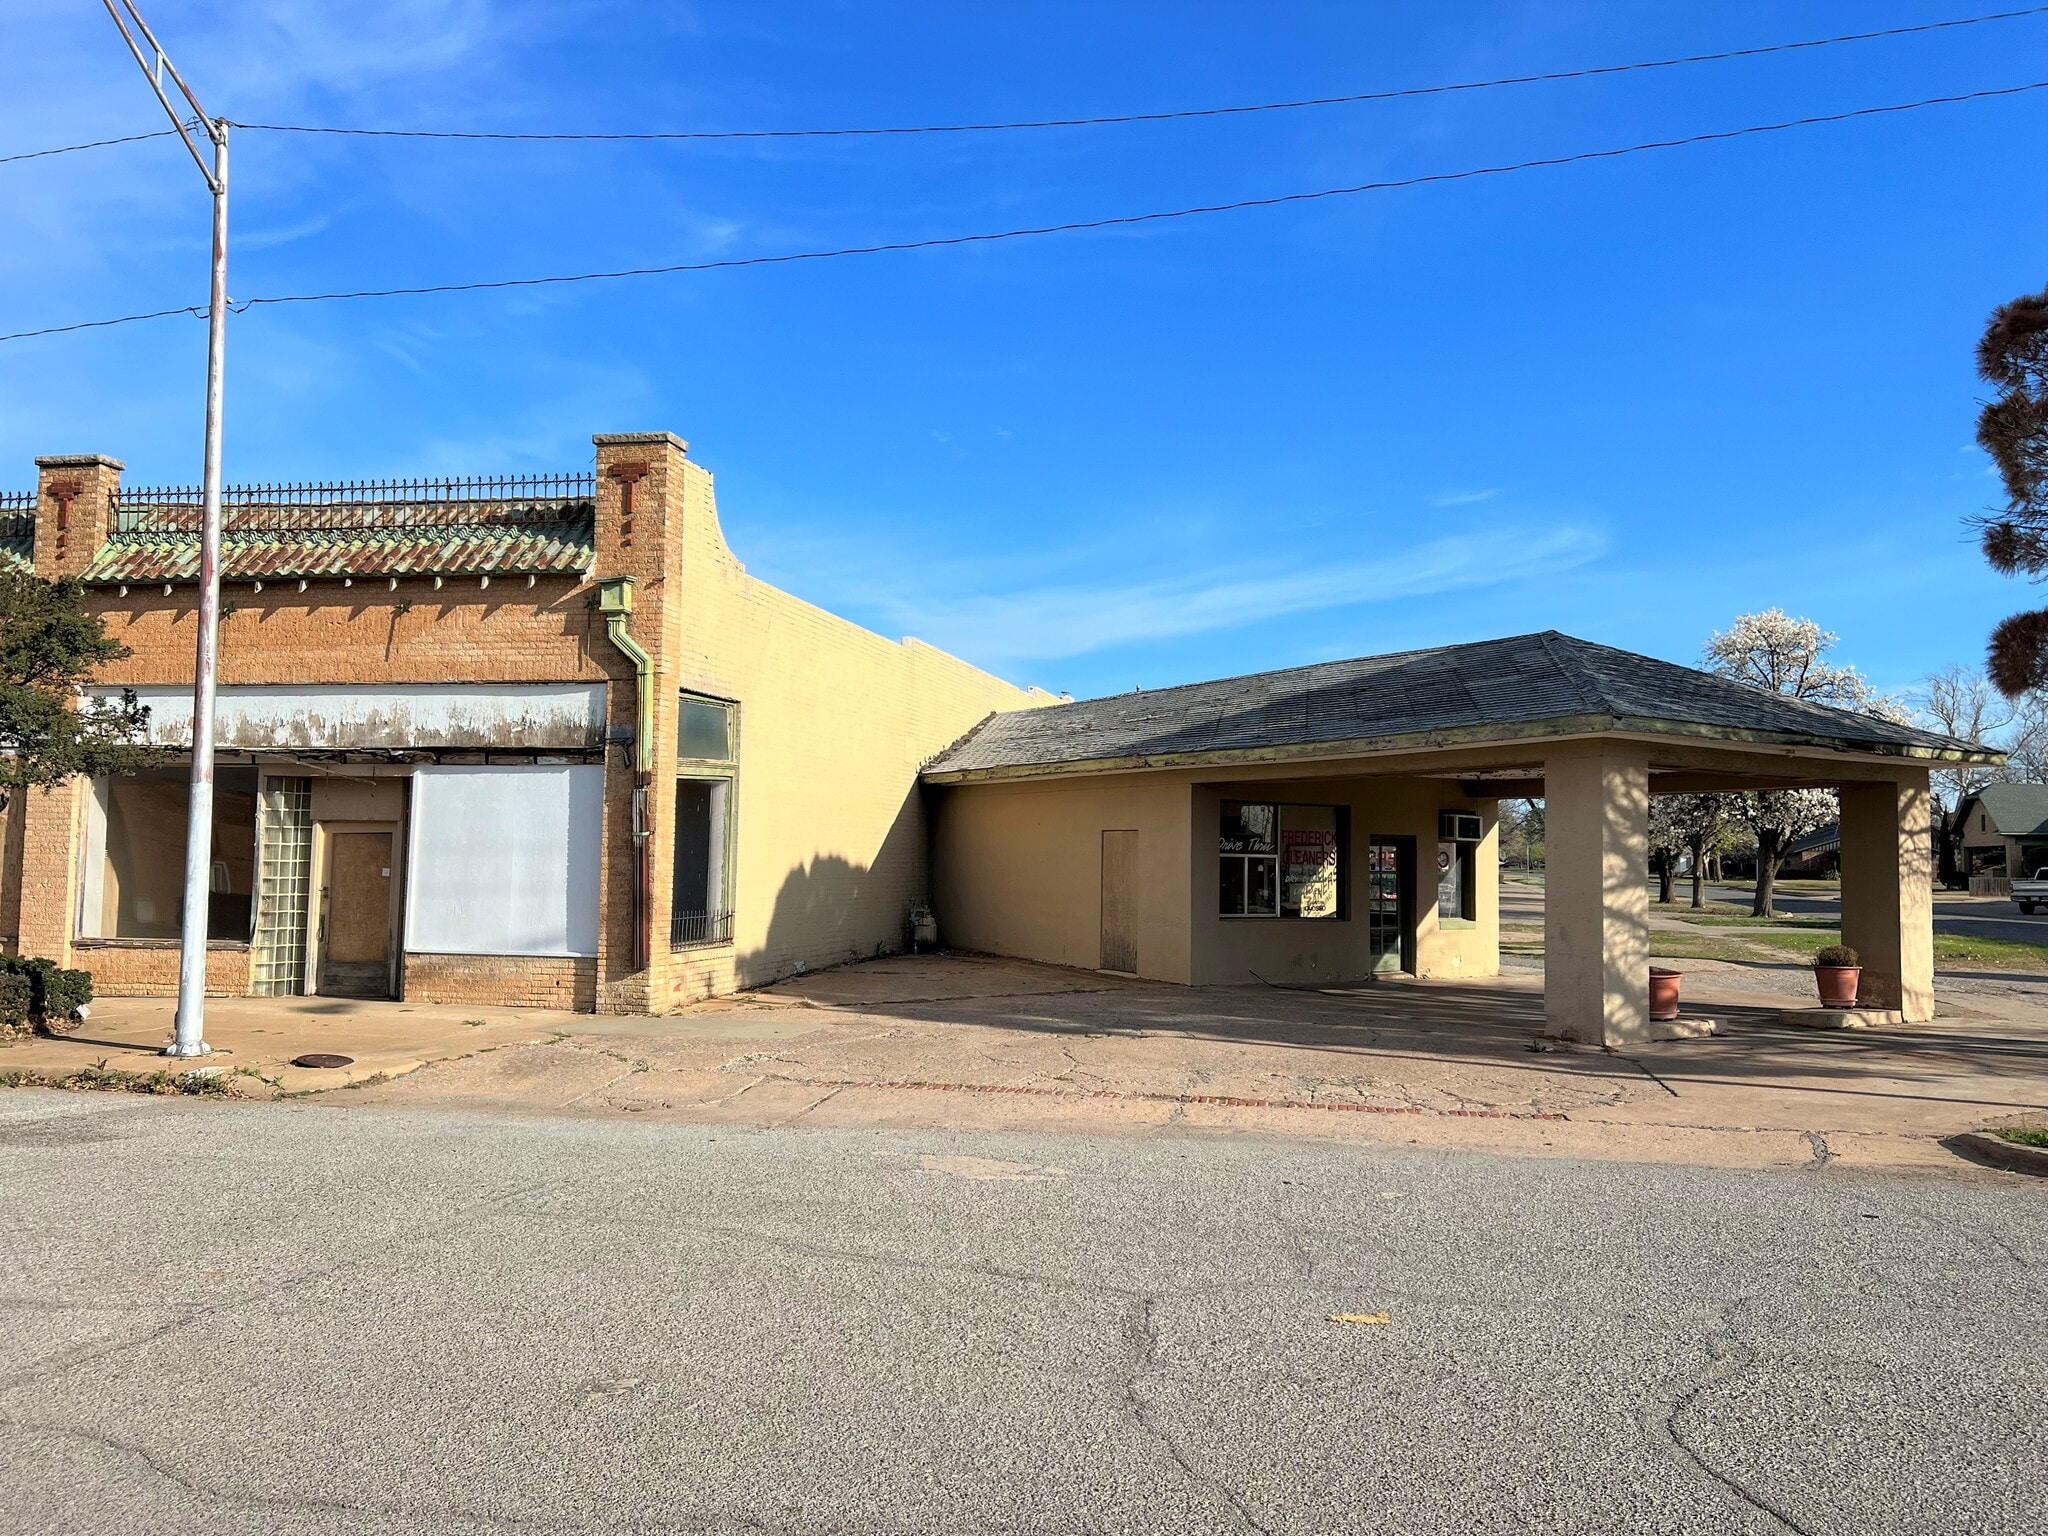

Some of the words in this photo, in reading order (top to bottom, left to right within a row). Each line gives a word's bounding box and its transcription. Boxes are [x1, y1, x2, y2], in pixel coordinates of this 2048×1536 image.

[1219, 837, 1243, 851] Drive
[1248, 837, 1275, 851] Thru
[1281, 829, 1337, 846] FREDERICK
[1282, 850, 1336, 866] CLEANERS
